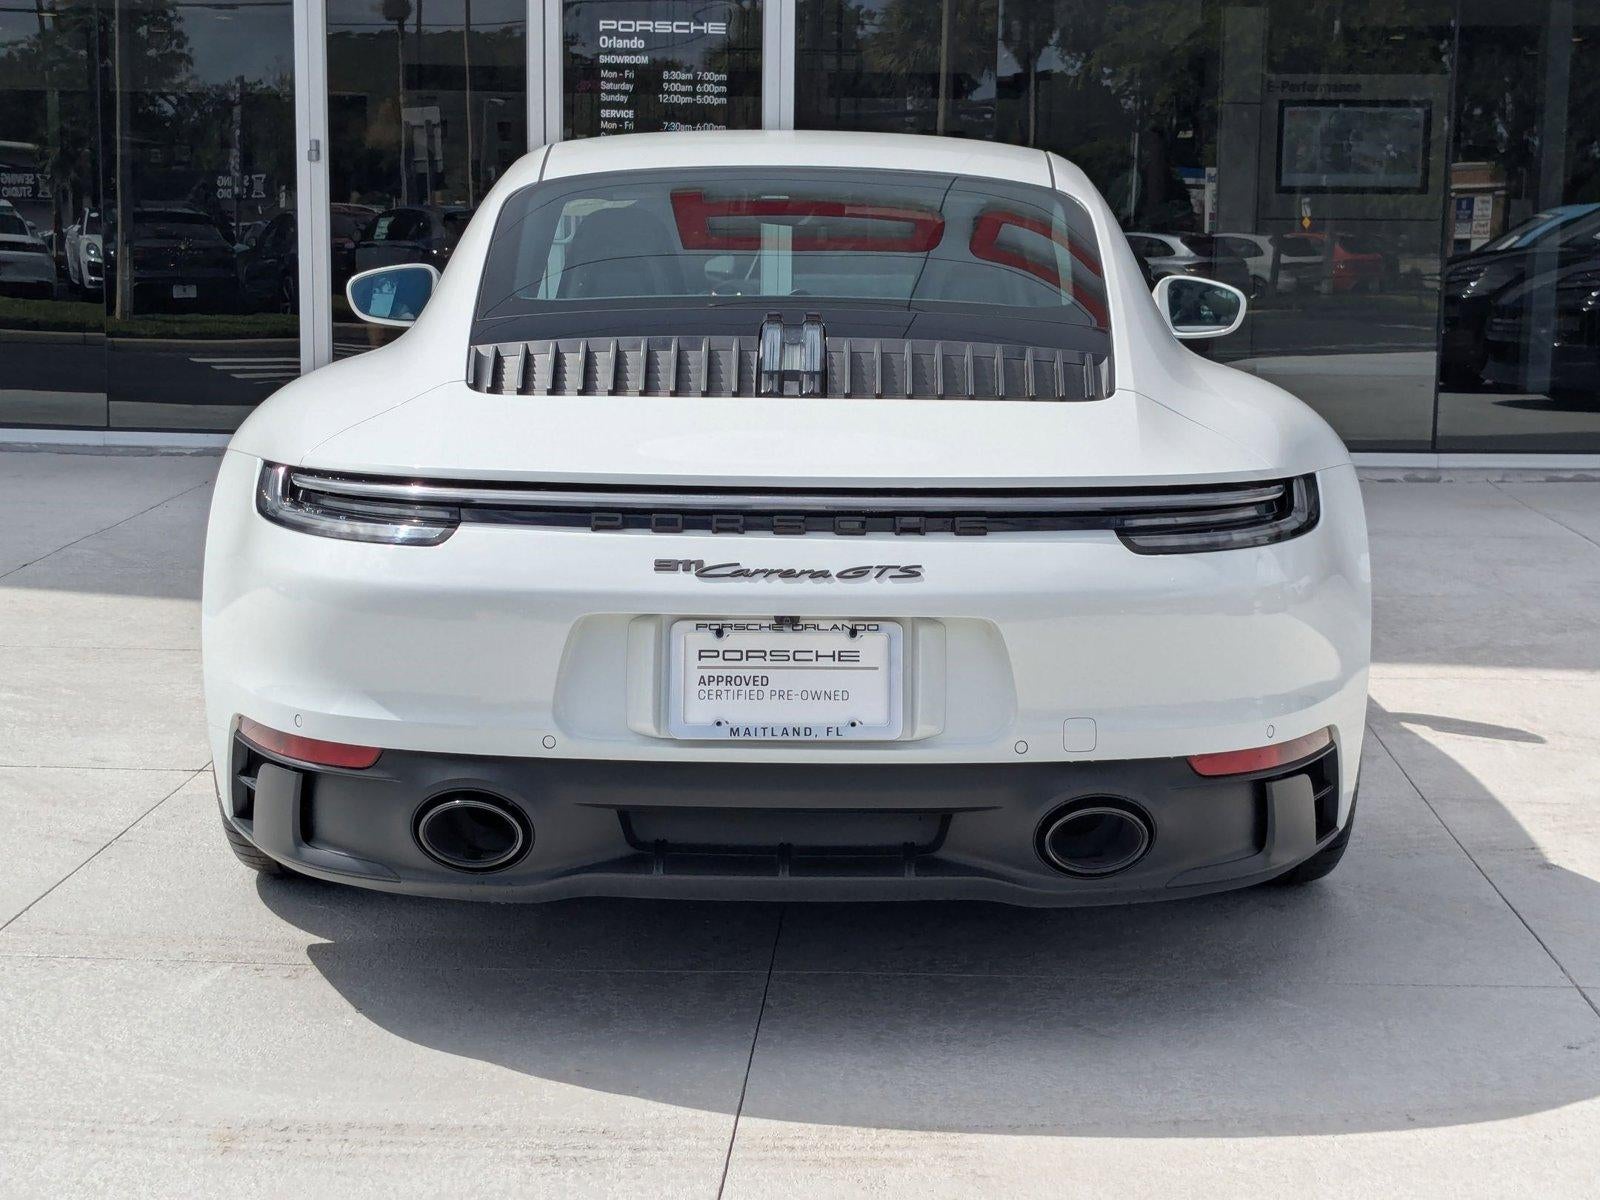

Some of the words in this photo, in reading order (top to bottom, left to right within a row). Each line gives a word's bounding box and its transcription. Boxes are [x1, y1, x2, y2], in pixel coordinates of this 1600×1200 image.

[599, 20, 727, 34] PORSCHE
[599, 36, 645, 49] Orlando
[599, 55, 649, 65] SHOWROOM
[600, 70, 618, 79] Mon
[624, 70, 635, 79] Fri
[662, 71, 694, 81] 8:30am
[696, 72, 727, 82] 7:00pm
[600, 82, 634, 93] Saturday
[662, 83, 693, 92] 9:00am
[696, 84, 727, 94] 6:00pm
[600, 93, 628, 104] Sunday
[600, 110, 634, 119] SERVICE
[600, 121, 617, 130] Mon
[624, 121, 634, 130] Fri
[590, 511, 988, 536] PORSCHE
[654, 558, 704, 572] 911
[695, 562, 832, 579] Carrera
[835, 565, 923, 579] GTS
[695, 623, 784, 632] PORSCHE
[791, 623, 880, 632] ORLANDO
[697, 649, 861, 663] PORSCHE
[697, 675, 770, 687] APPROVED
[697, 689, 765, 701] CERTIFIED
[769, 689, 850, 701] PRE-OWNED
[729, 726, 819, 738] MAITLAND,
[826, 726, 844, 737] FL
